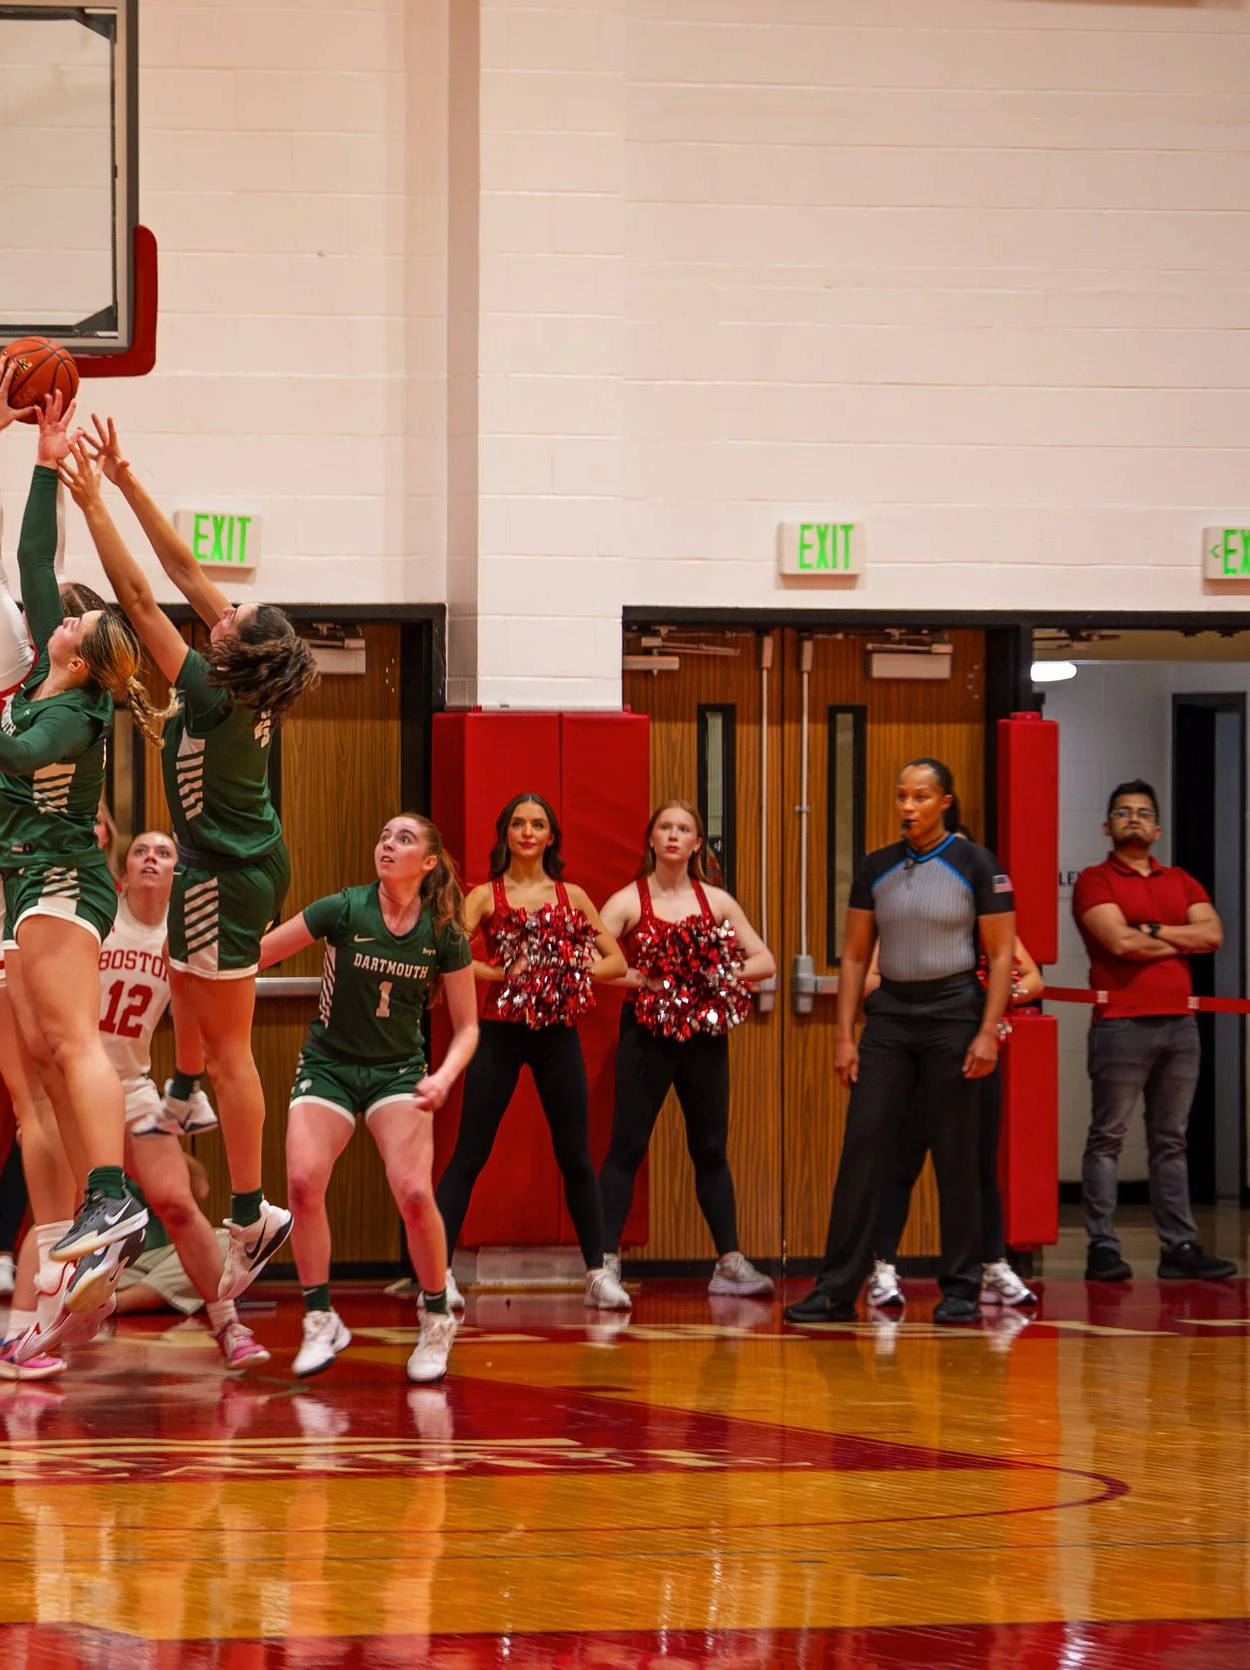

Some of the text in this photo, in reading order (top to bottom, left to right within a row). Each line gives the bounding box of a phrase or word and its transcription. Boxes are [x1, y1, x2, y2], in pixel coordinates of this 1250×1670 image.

[193, 513, 252, 562] EXIT
[798, 523, 855, 568] EXIT
[353, 952, 429, 979] DARTMOUTH
[98, 979, 153, 1038] 12
[375, 980, 394, 1018] 1
